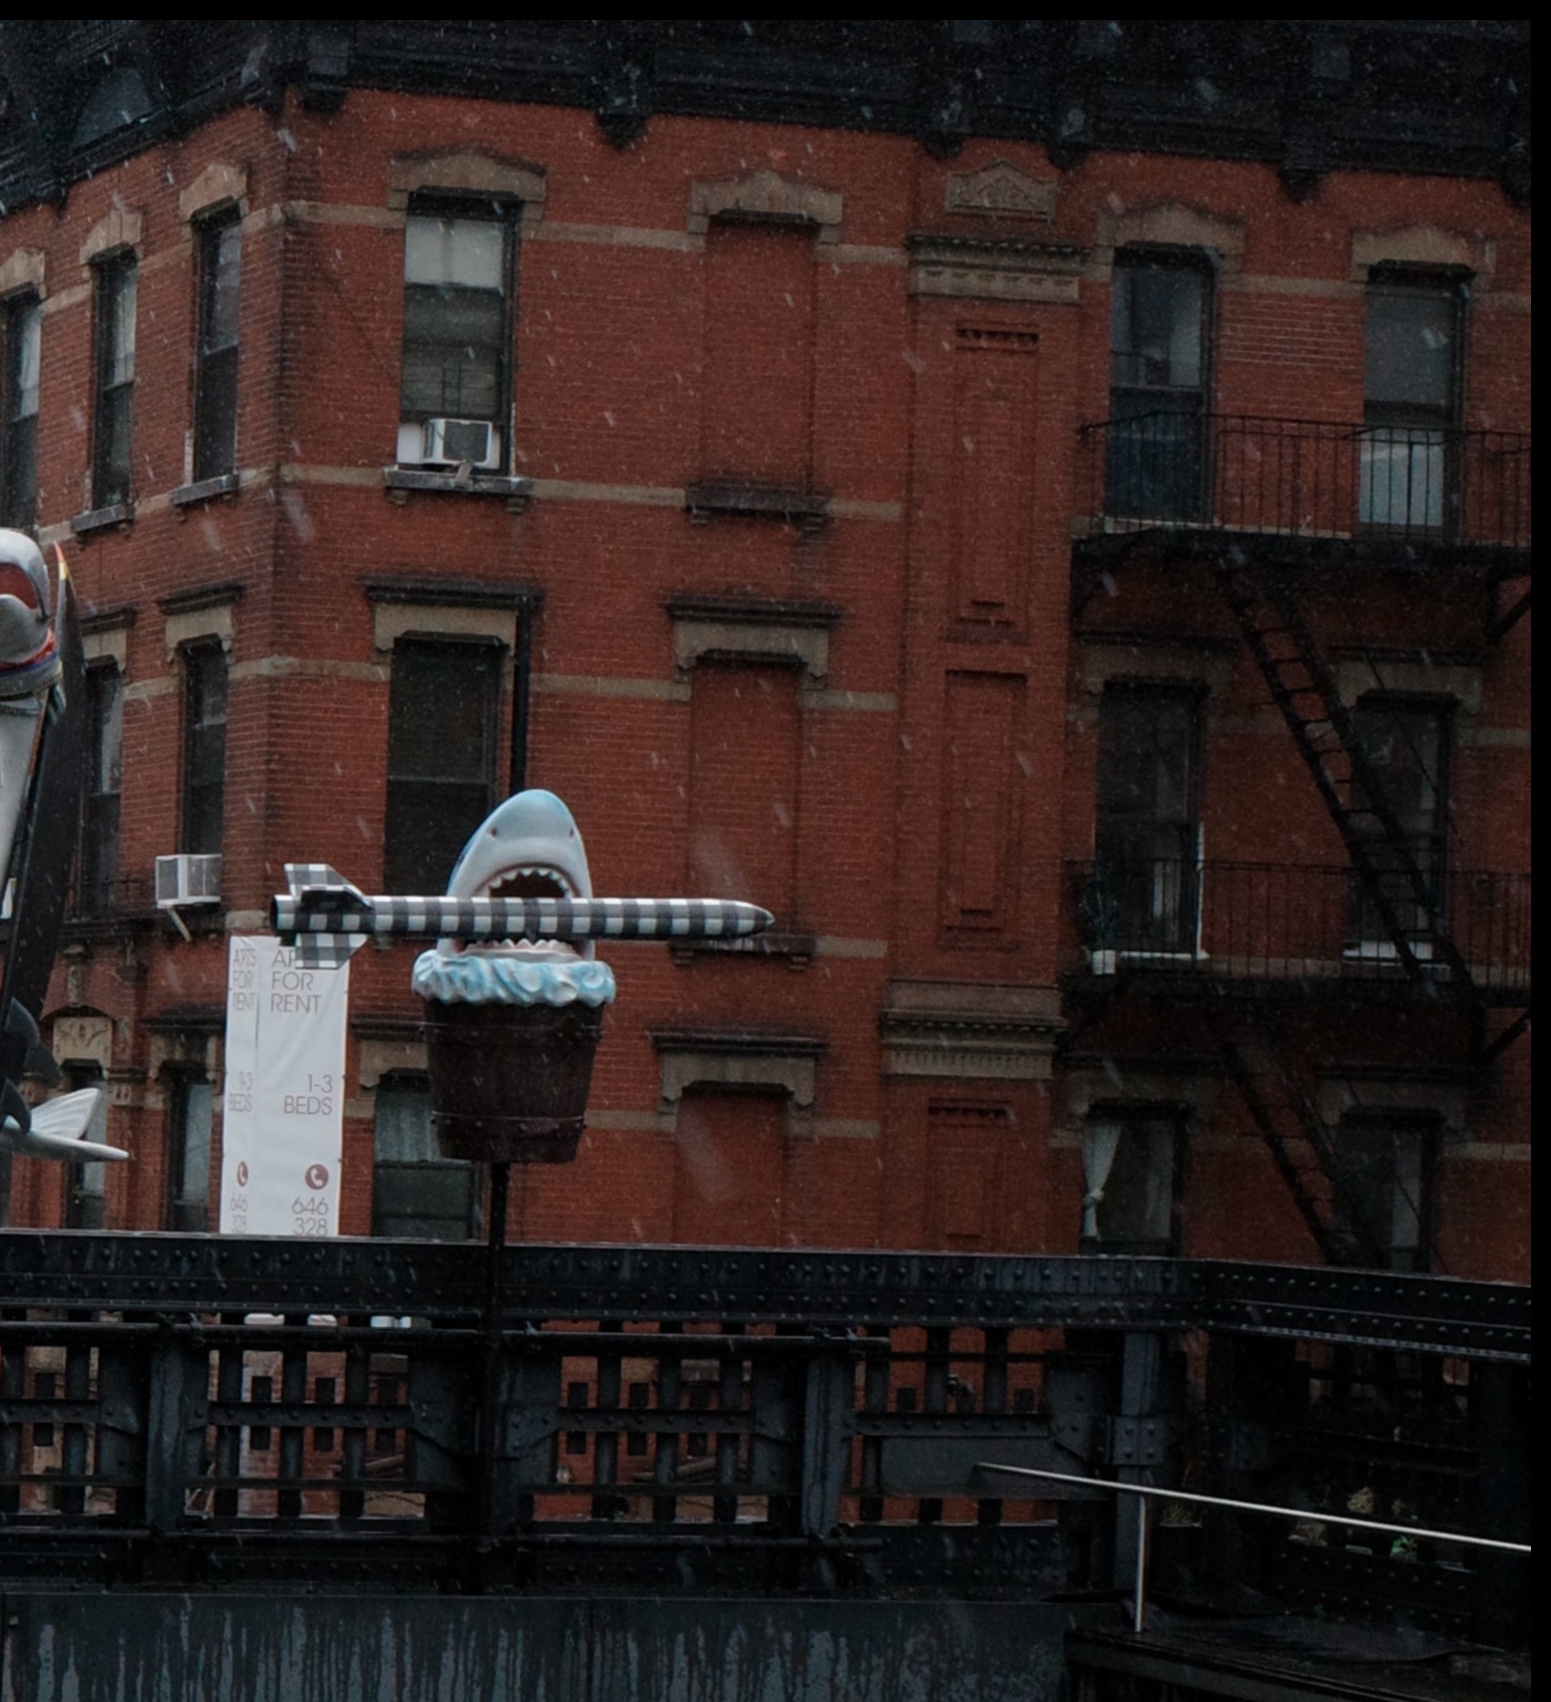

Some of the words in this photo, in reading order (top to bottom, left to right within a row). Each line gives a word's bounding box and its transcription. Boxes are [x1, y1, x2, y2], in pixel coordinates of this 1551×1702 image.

[272, 971, 314, 991] FOR
[271, 993, 322, 1013] RENT
[307, 1074, 333, 1093] 1-3
[283, 1095, 332, 1116] BEDS
[292, 1196, 329, 1216] 646
[293, 1217, 328, 1236] 328
